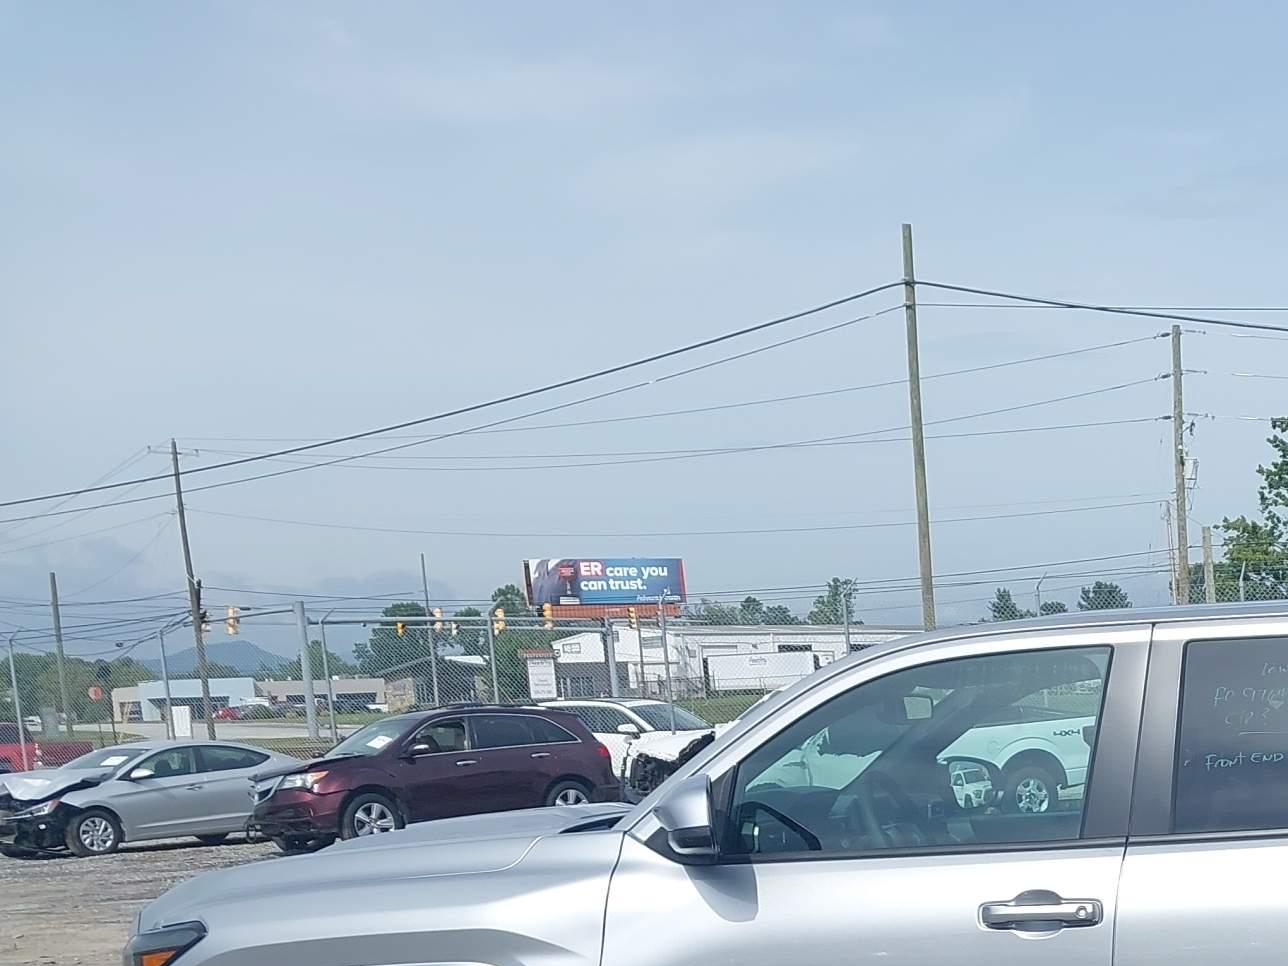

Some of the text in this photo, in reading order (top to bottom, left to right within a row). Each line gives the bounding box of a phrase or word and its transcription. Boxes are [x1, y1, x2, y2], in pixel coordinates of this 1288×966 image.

[579, 562, 602, 576] ER
[606, 566, 638, 577] care
[640, 566, 668, 579] you
[580, 578, 647, 591] can trust.
[1250, 752, 1284, 763] END
